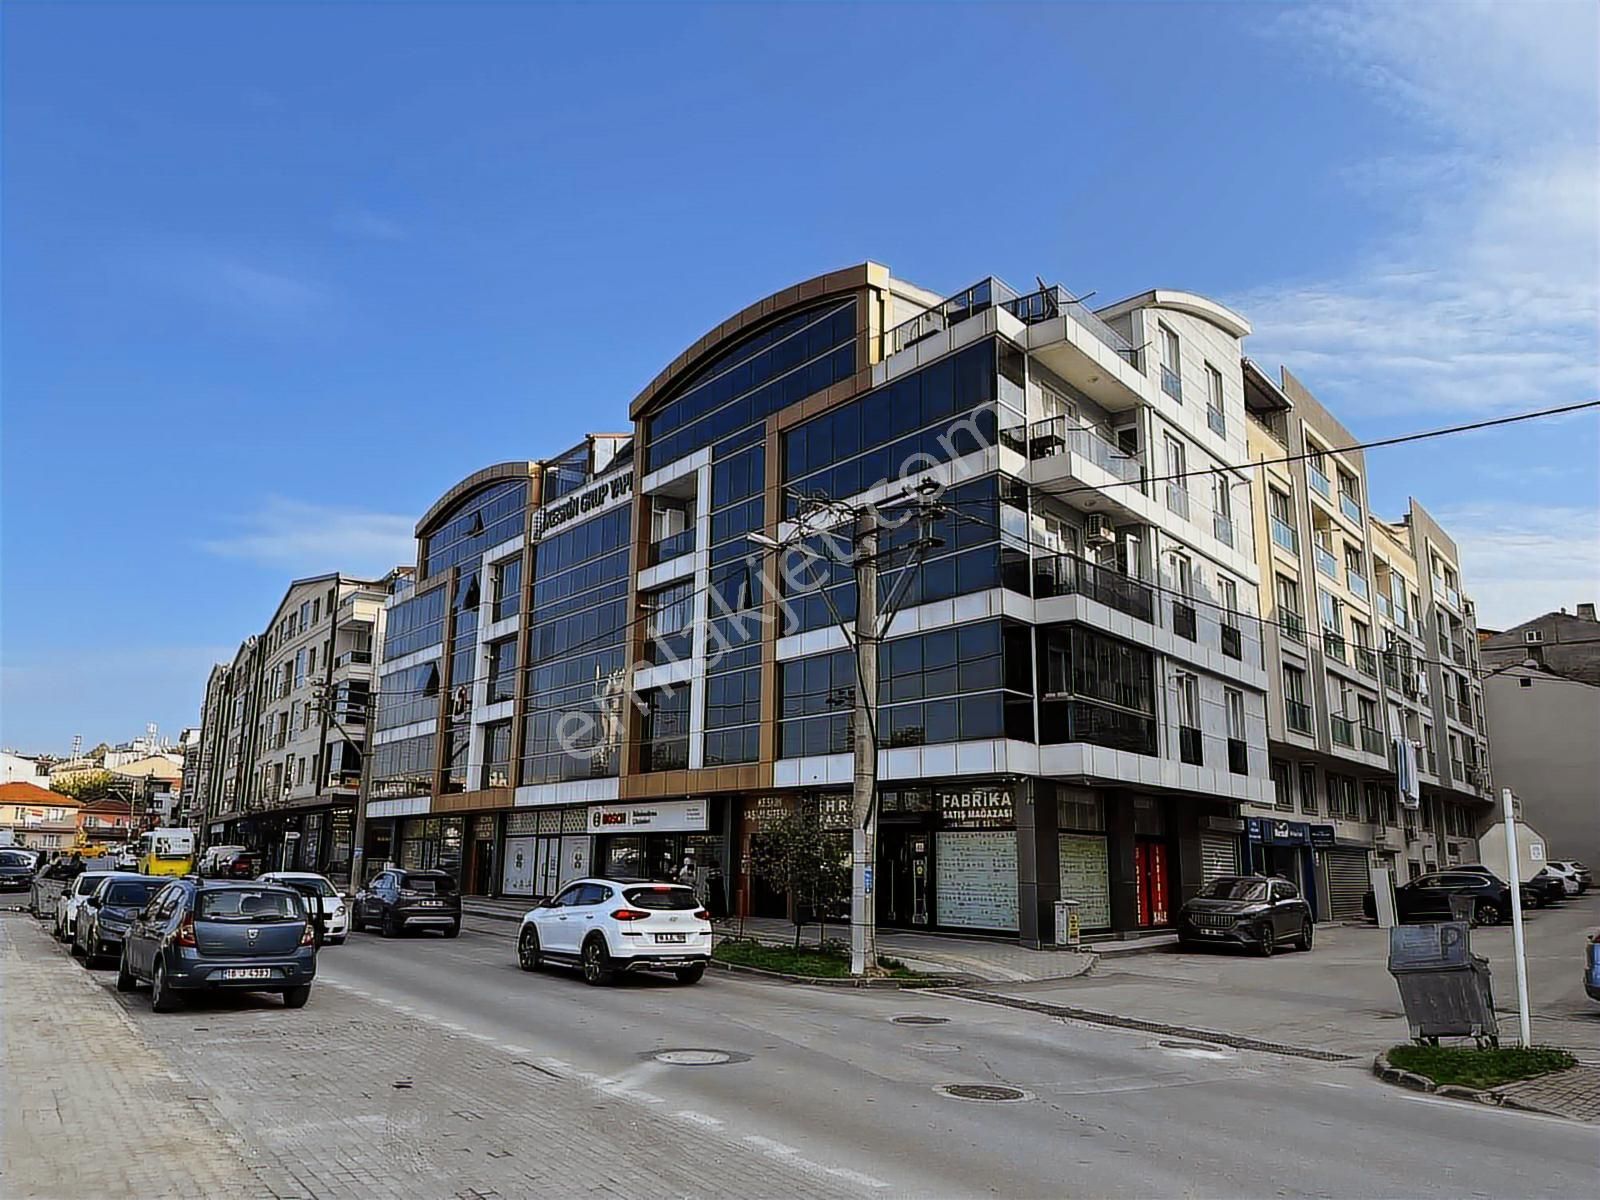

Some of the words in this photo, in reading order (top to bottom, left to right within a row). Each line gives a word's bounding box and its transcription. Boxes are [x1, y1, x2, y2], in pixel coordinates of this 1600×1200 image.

[581, 484, 609, 513] GRUP
[609, 471, 634, 499] YAPI
[942, 792, 1012, 808] FABRİKA
[602, 812, 627, 825] BOSCH
[943, 810, 966, 820] SATIŞ
[967, 808, 1013, 818] MAĞAZASI
